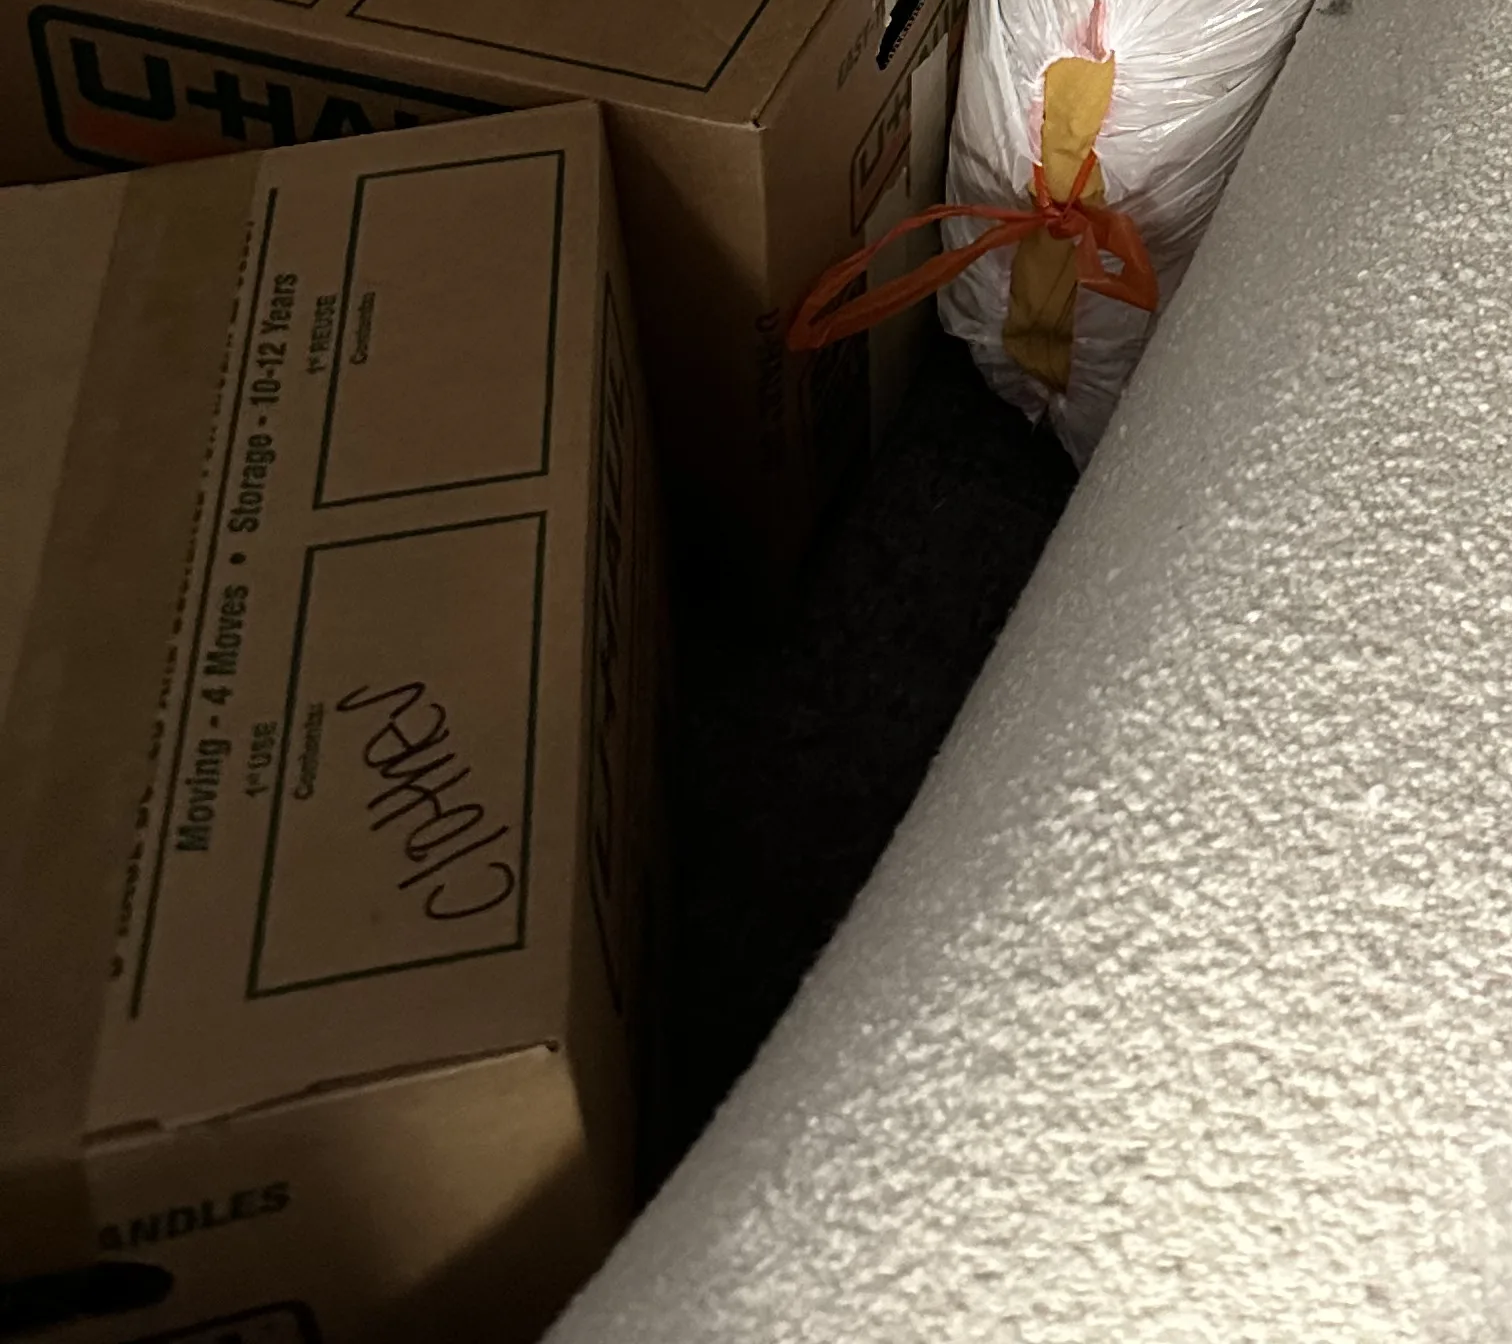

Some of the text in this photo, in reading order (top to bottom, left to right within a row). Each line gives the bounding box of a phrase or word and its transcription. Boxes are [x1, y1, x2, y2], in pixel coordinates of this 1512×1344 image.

[69, 36, 419, 146] U-HA
[259, 272, 299, 336] Years
[250, 341, 288, 406] 10-12
[226, 432, 278, 534] Storage
[203, 584, 251, 678] Moves
[201, 684, 234, 706] 4
[175, 738, 233, 853] Moving
[99, 1180, 292, 1251] ANDLES
